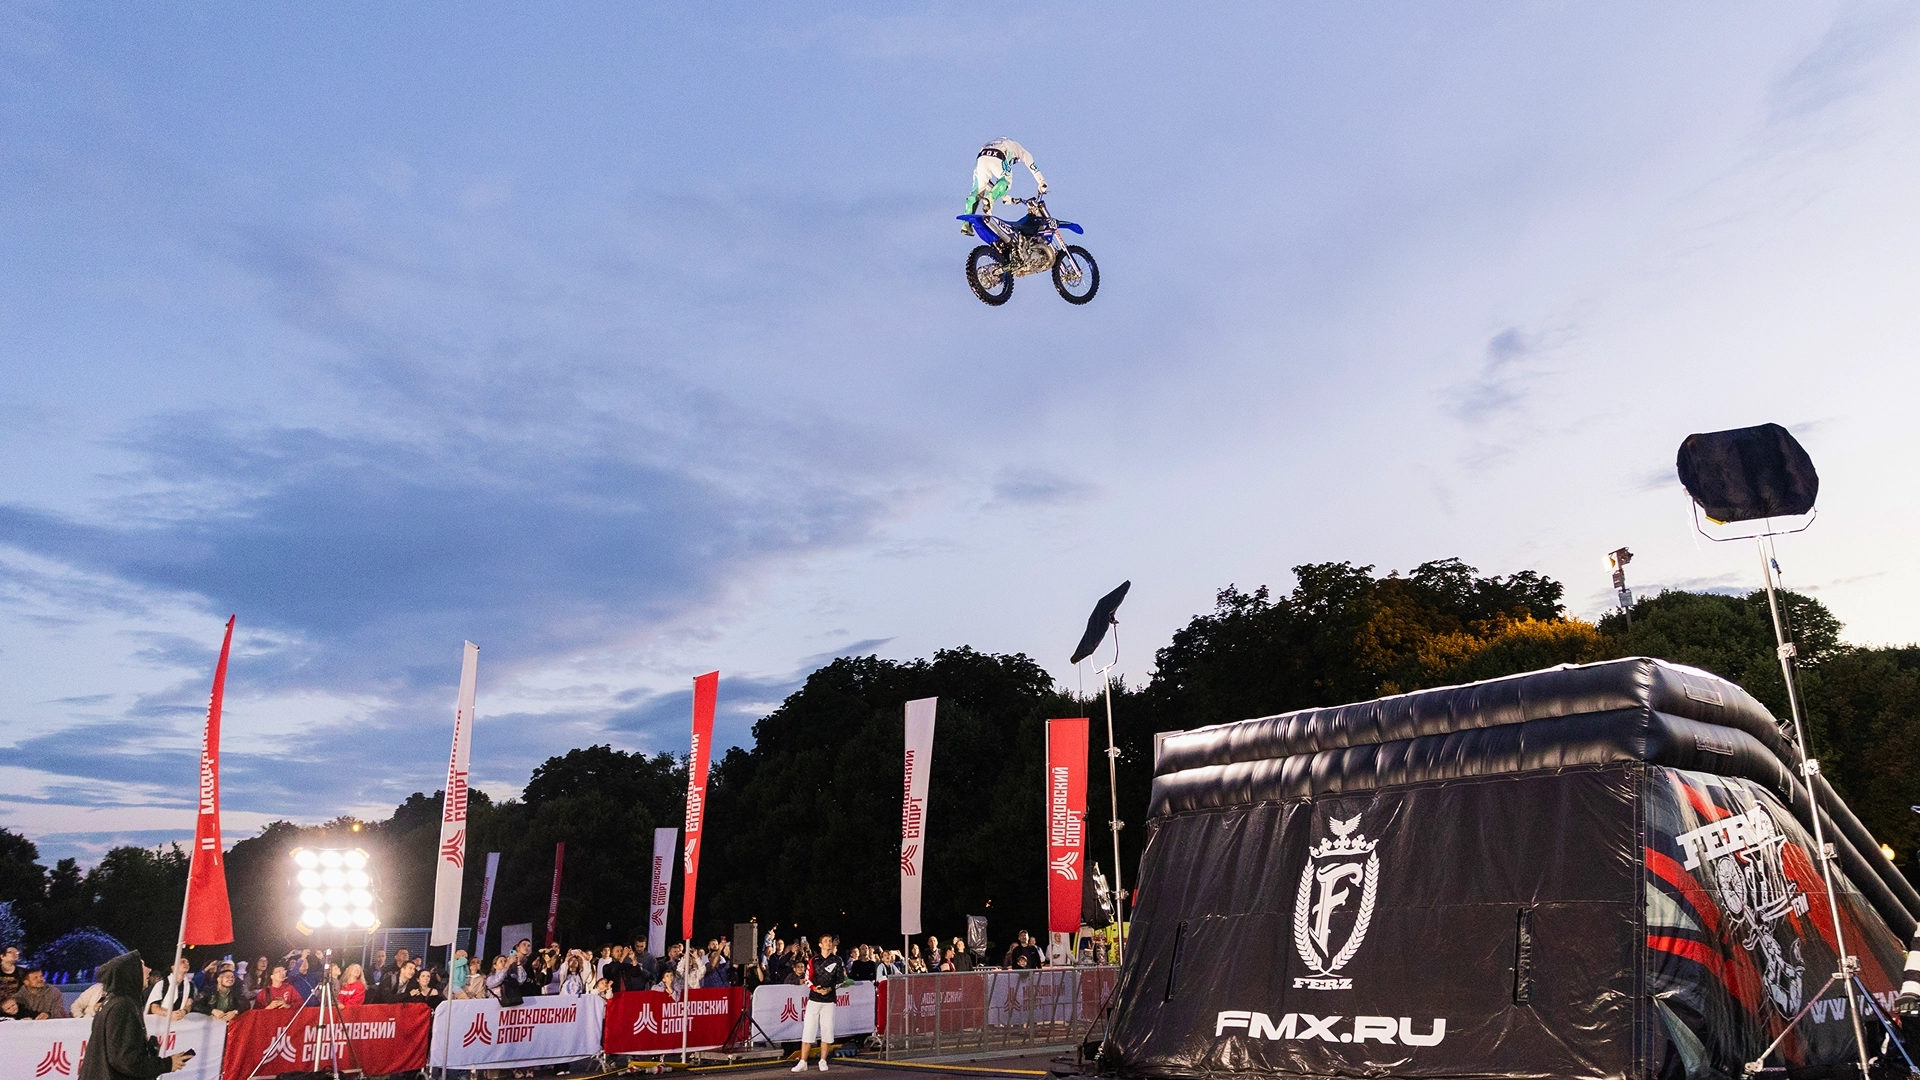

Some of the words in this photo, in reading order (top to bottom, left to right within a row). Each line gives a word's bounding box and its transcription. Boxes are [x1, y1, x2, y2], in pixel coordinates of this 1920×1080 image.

[454, 770, 468, 822] СПОРТ
[690, 785, 703, 832] СПОРТ
[1051, 766, 1069, 847] МОСКОВСКИЙ
[907, 796, 923, 839] СПОРТ
[1065, 808, 1081, 847] СПОРТ
[1675, 806, 1767, 871] FERZ
[657, 882, 668, 906] СПОРТ
[1293, 977, 1353, 990] FERZ
[498, 1003, 577, 1026] МОСКОВСКИЙ
[662, 996, 728, 1018] МОСКОВСКИЙ
[497, 1026, 535, 1044] СПОРТ
[1215, 1010, 1446, 1046] FMX.RU
